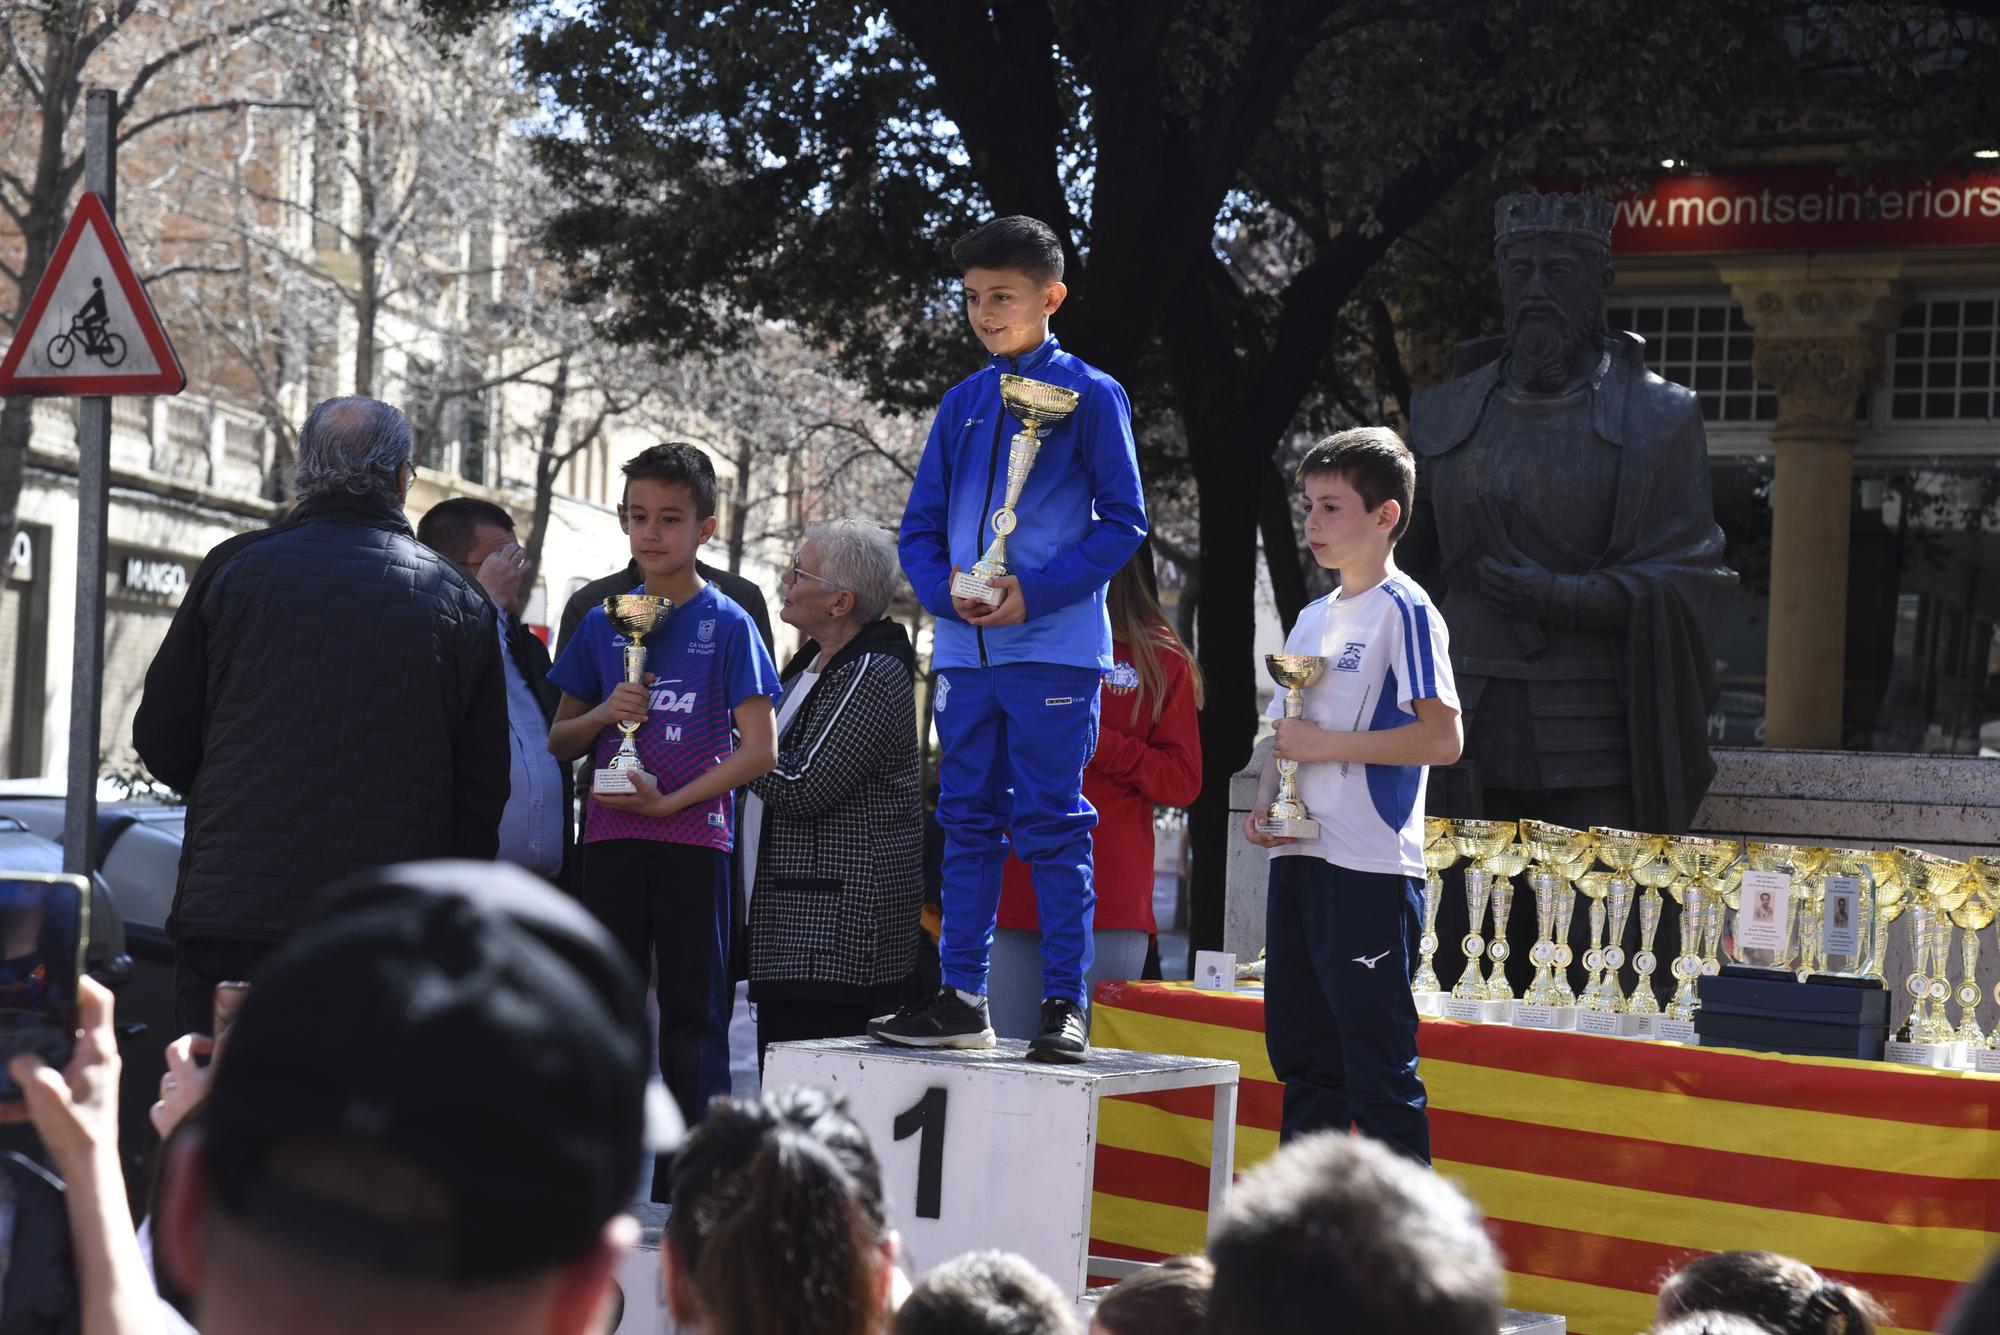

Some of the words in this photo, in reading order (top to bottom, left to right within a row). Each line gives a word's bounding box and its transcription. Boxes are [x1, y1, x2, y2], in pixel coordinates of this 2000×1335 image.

[126, 557, 186, 595] MANGO
[648, 689, 697, 714] IDA
[665, 725, 682, 742] M
[893, 1086, 948, 1220] 1
